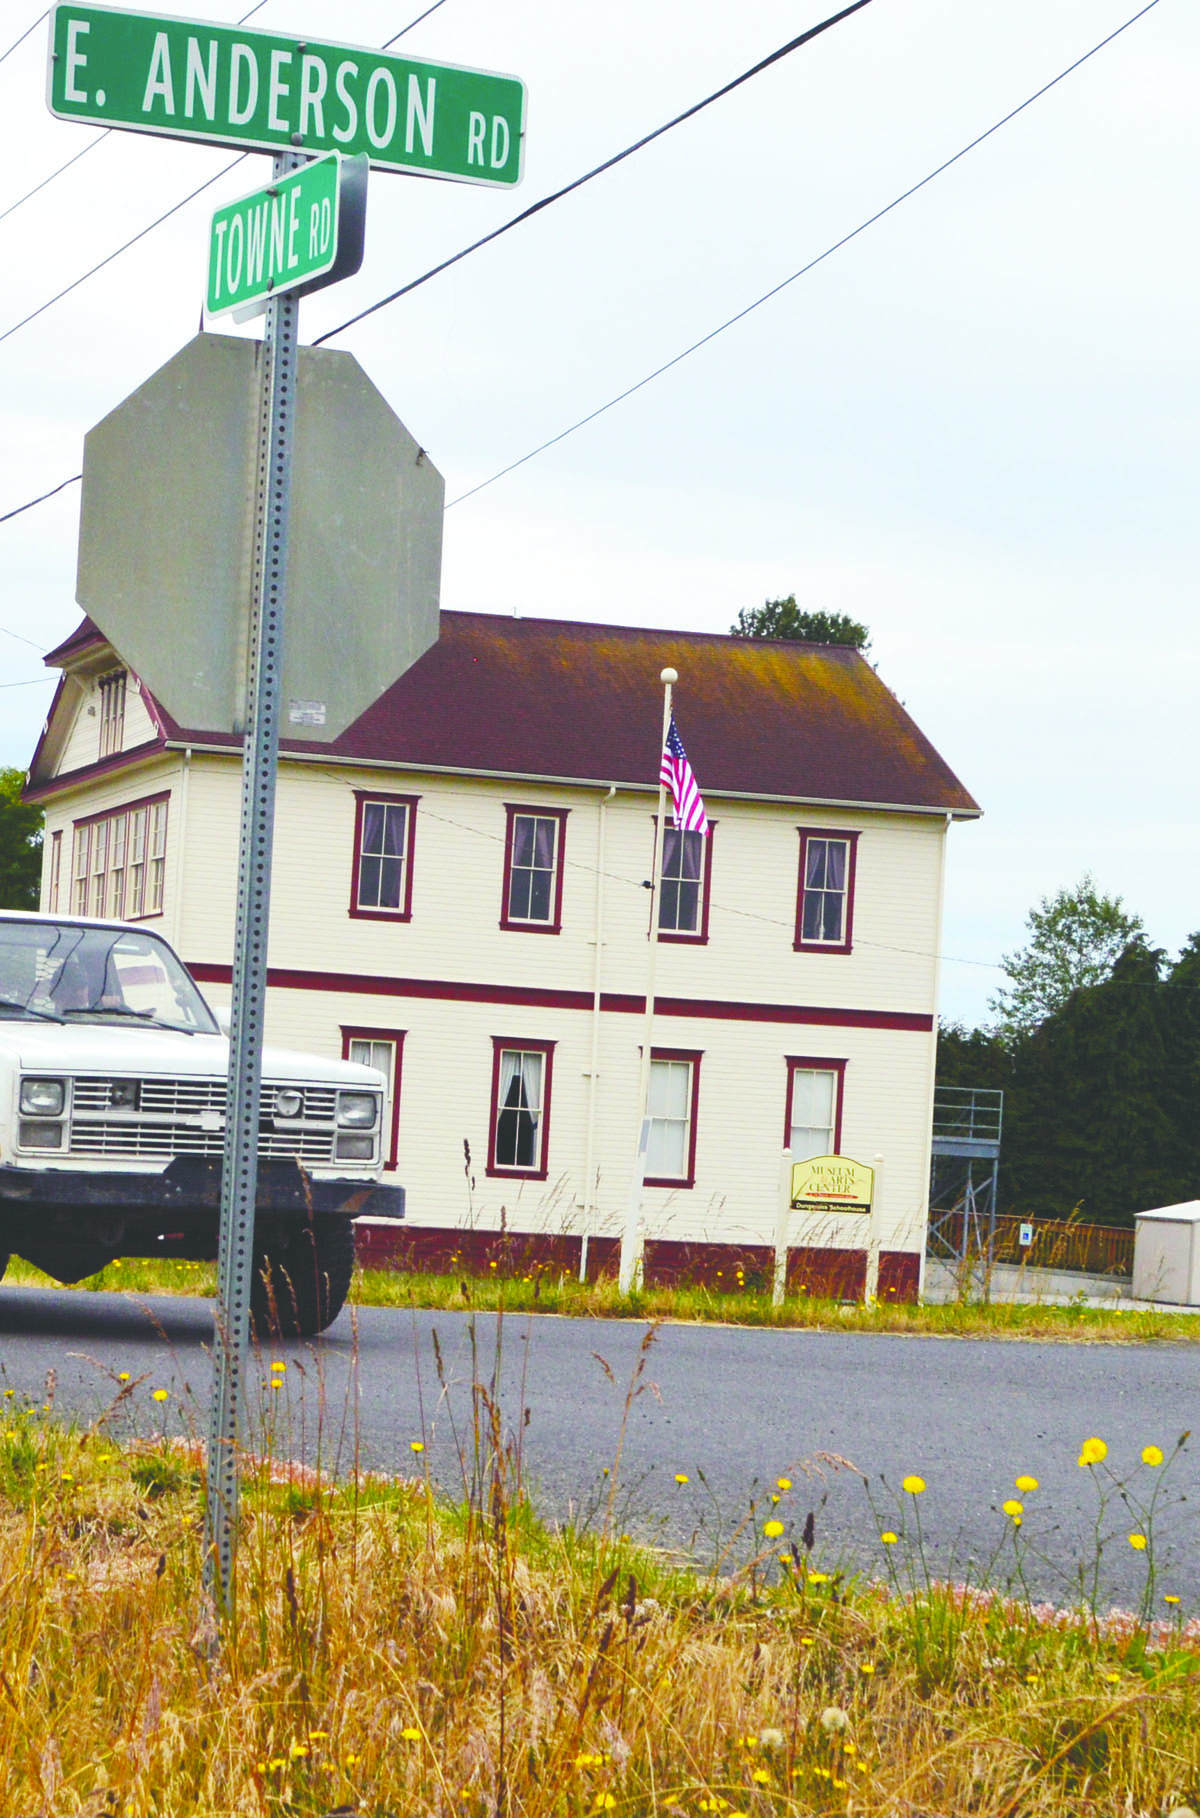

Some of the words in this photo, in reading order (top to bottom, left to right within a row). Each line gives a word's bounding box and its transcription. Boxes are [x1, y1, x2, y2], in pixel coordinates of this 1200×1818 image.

[64, 19, 107, 108] E.
[142, 31, 437, 157] ANDERSON
[467, 111, 511, 169] RD
[214, 184, 302, 300] TOWNE
[309, 197, 332, 261] RD
[812, 1166, 855, 1176] MUSEUM
[831, 1176, 855, 1185] ARTS
[809, 1184, 851, 1193] CENTER
